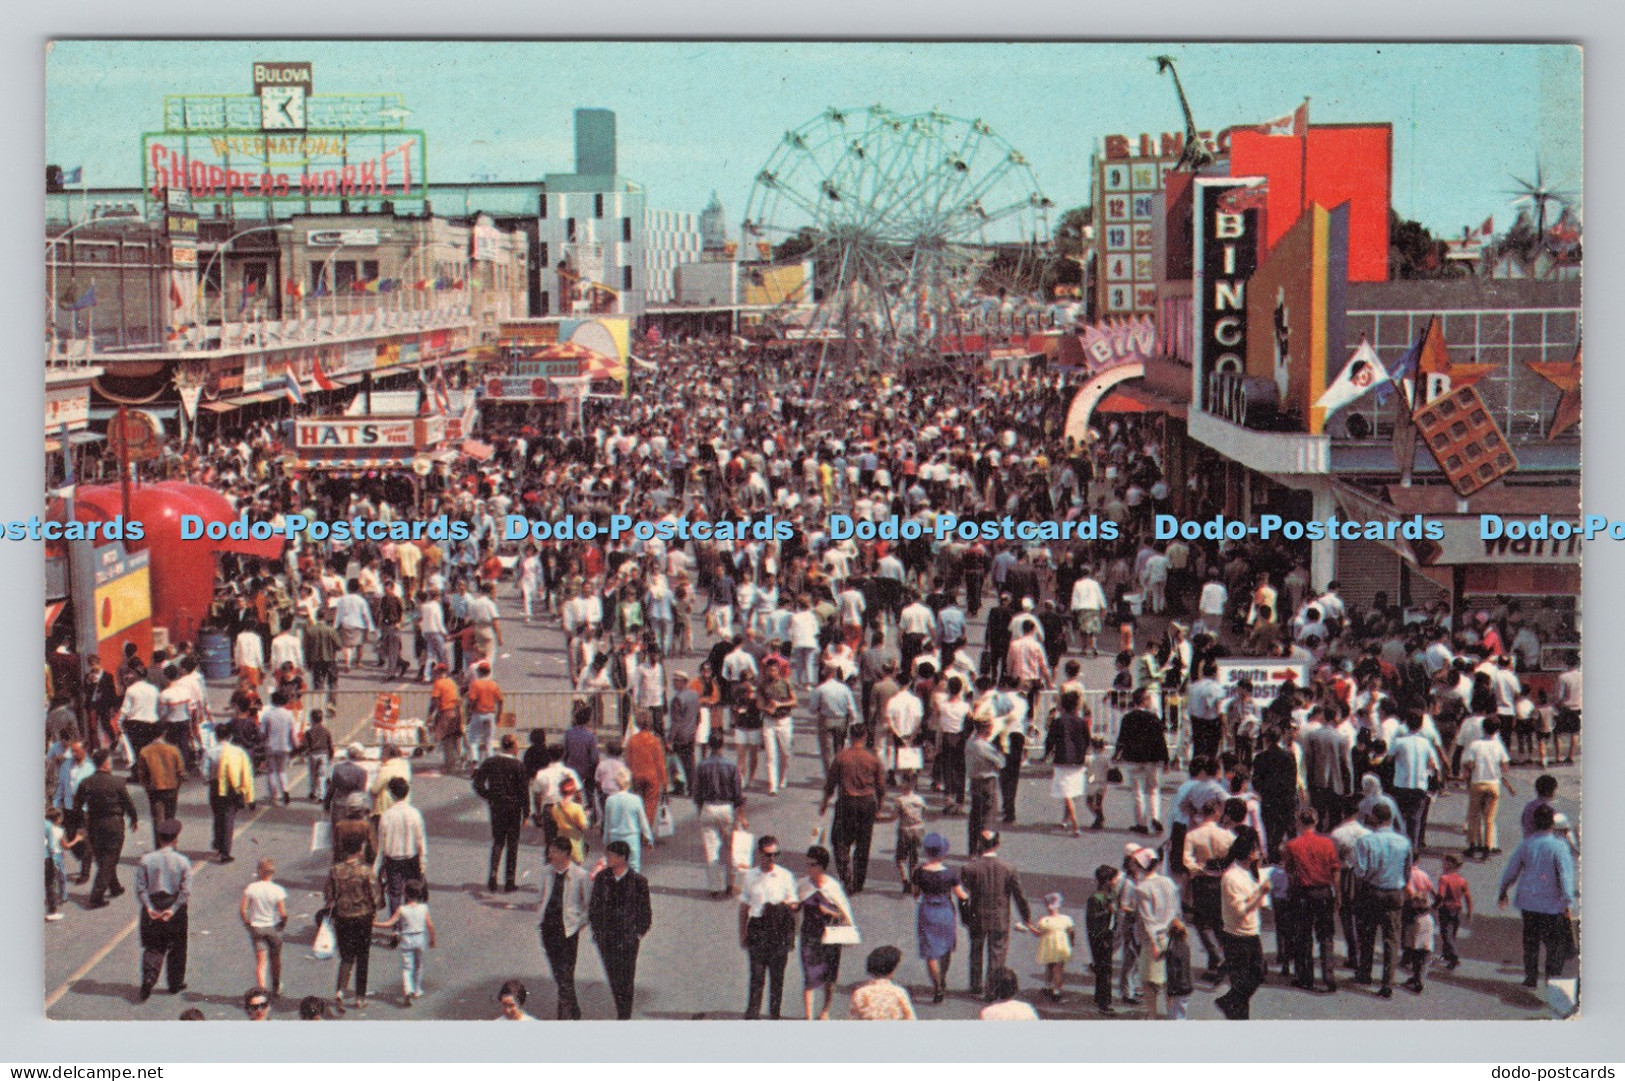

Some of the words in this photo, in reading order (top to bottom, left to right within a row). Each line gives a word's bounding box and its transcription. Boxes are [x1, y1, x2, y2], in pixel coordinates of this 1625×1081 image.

[210, 136, 349, 158] INTERNATIONAL
[151, 143, 290, 199] SHOPPERS
[300, 138, 416, 196] MARKET
[302, 424, 379, 446] HATS
[1228, 668, 1268, 682] SOUTH
